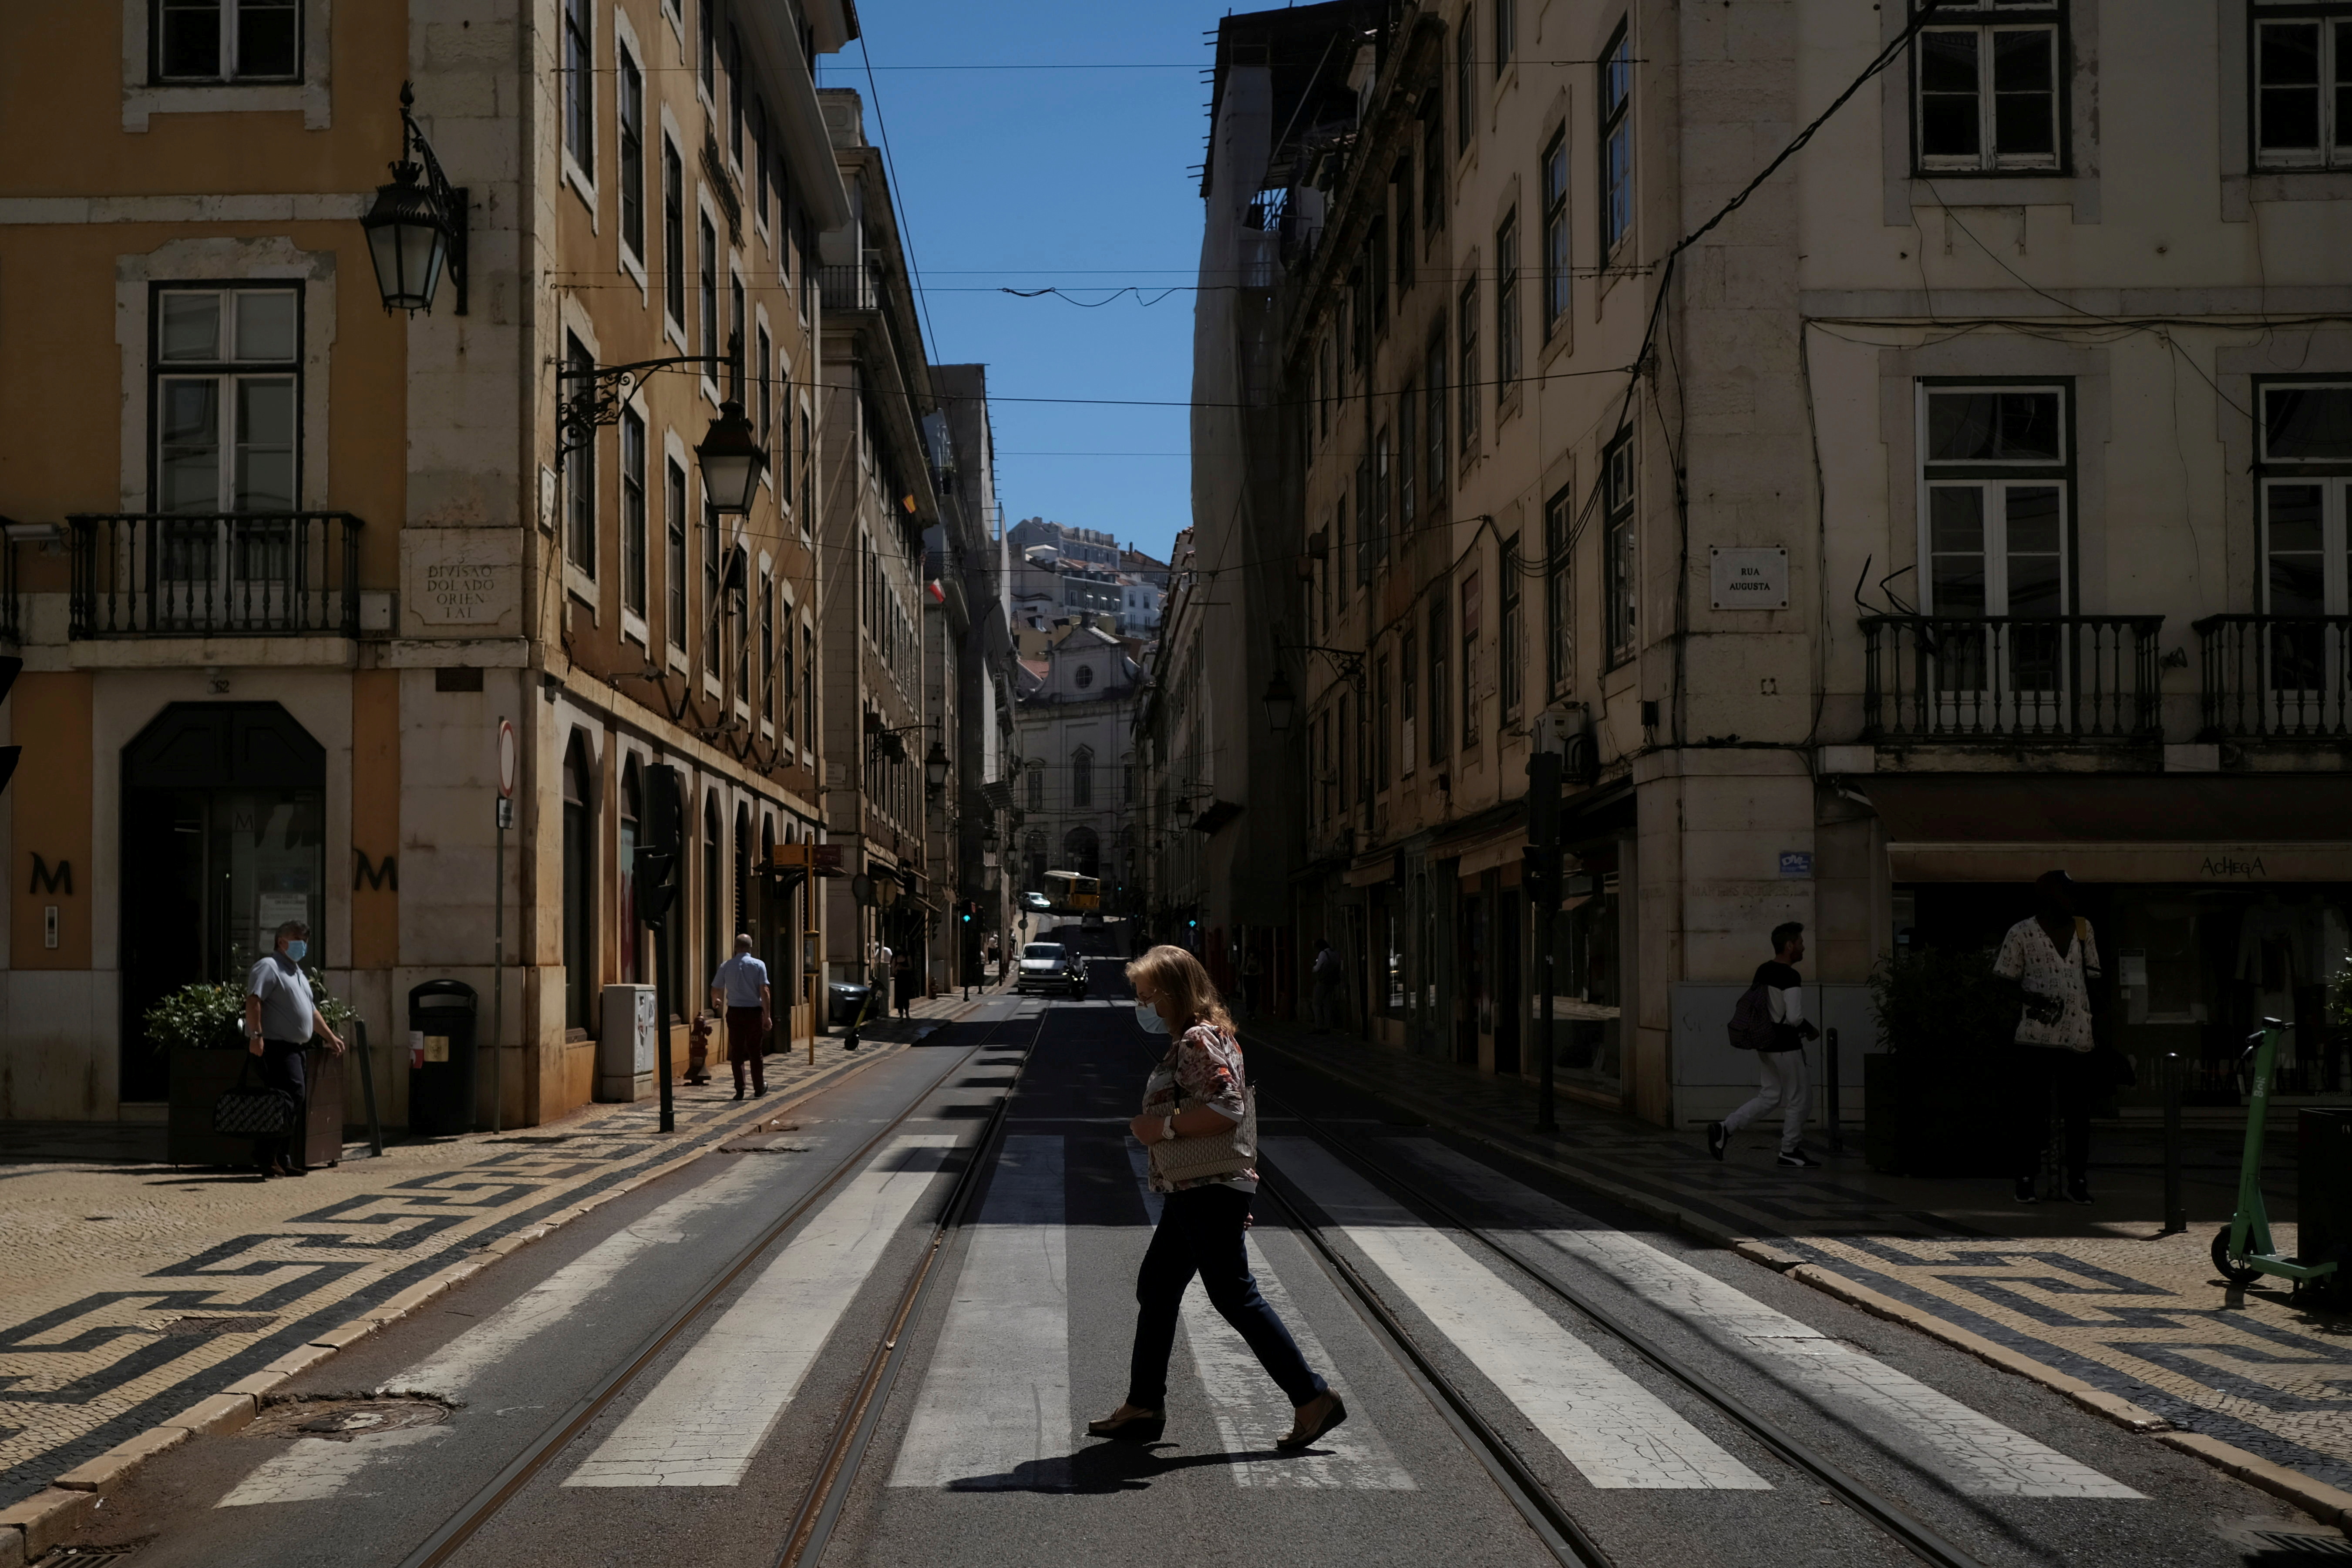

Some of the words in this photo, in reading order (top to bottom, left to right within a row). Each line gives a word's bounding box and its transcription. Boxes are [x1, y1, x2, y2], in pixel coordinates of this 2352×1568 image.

[235, 811, 254, 830] M
[29, 851, 72, 894] M
[353, 848, 398, 892] M
